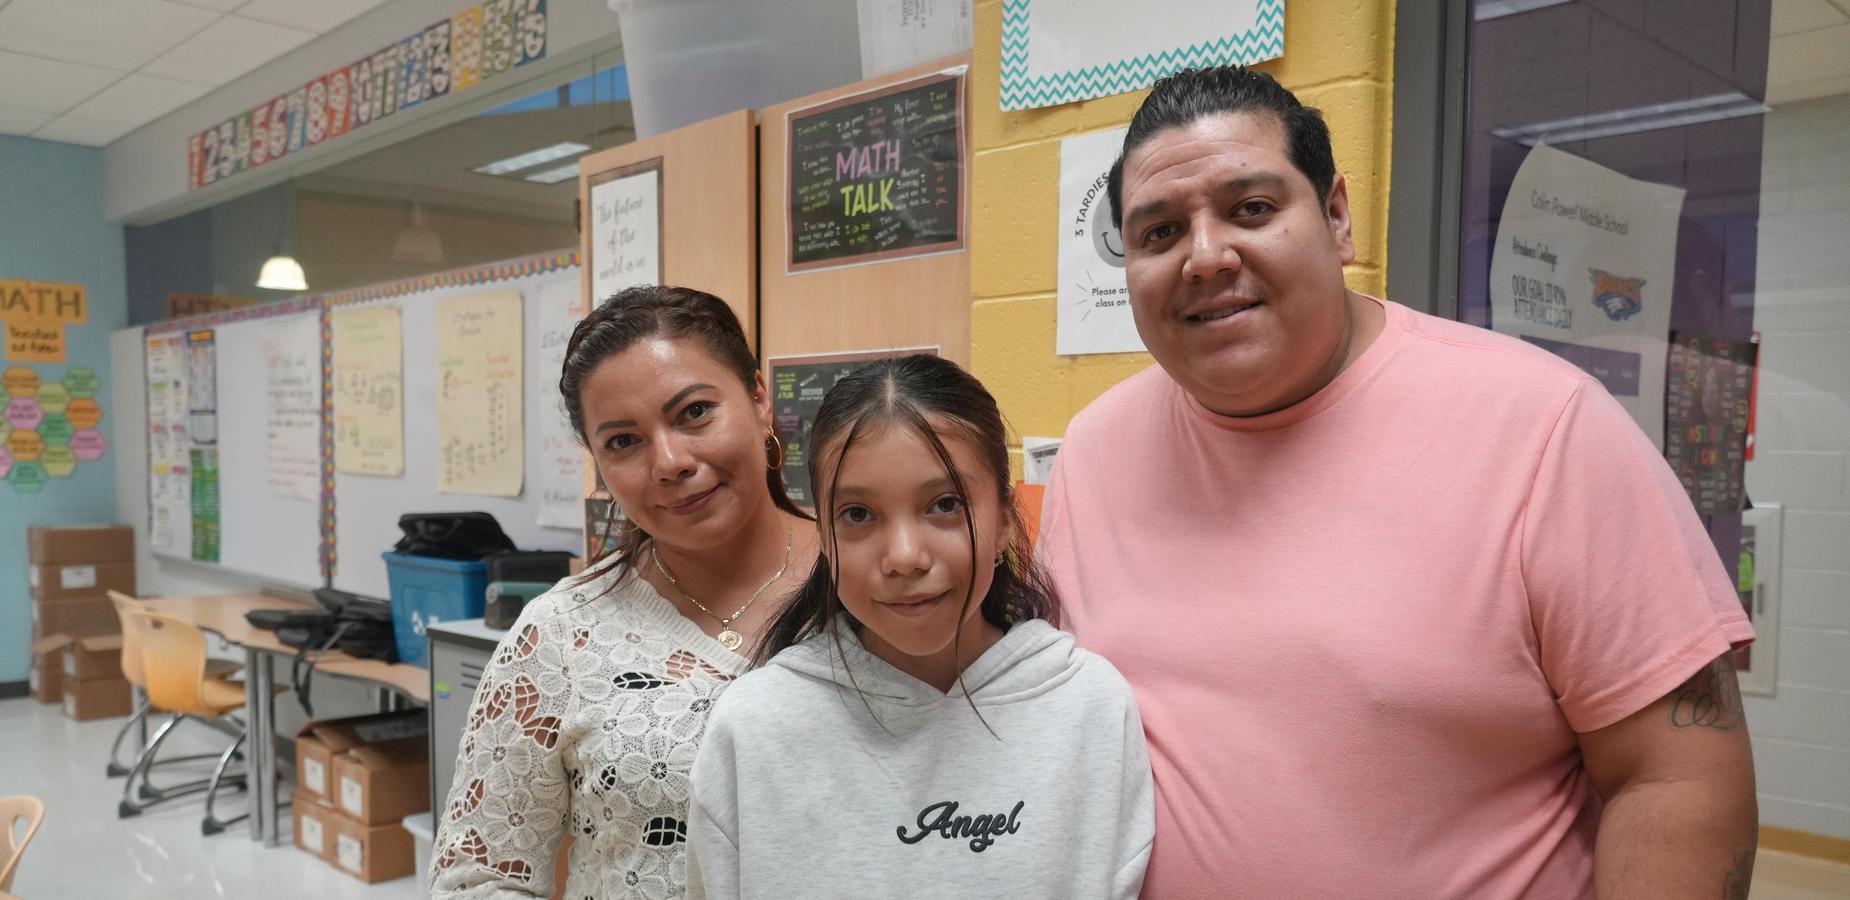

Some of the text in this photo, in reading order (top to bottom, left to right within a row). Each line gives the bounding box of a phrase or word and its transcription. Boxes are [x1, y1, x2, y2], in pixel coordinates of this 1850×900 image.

[836, 138, 901, 182] MATH
[840, 178, 894, 217] TALK
[1074, 172, 1111, 238] 3 TARDIES
[1551, 197, 1579, 222] Powell
[1603, 213, 1629, 236] School
[1092, 287, 1117, 297] Please
[1095, 298, 1115, 308] class
[896, 801, 1025, 853] Angel
